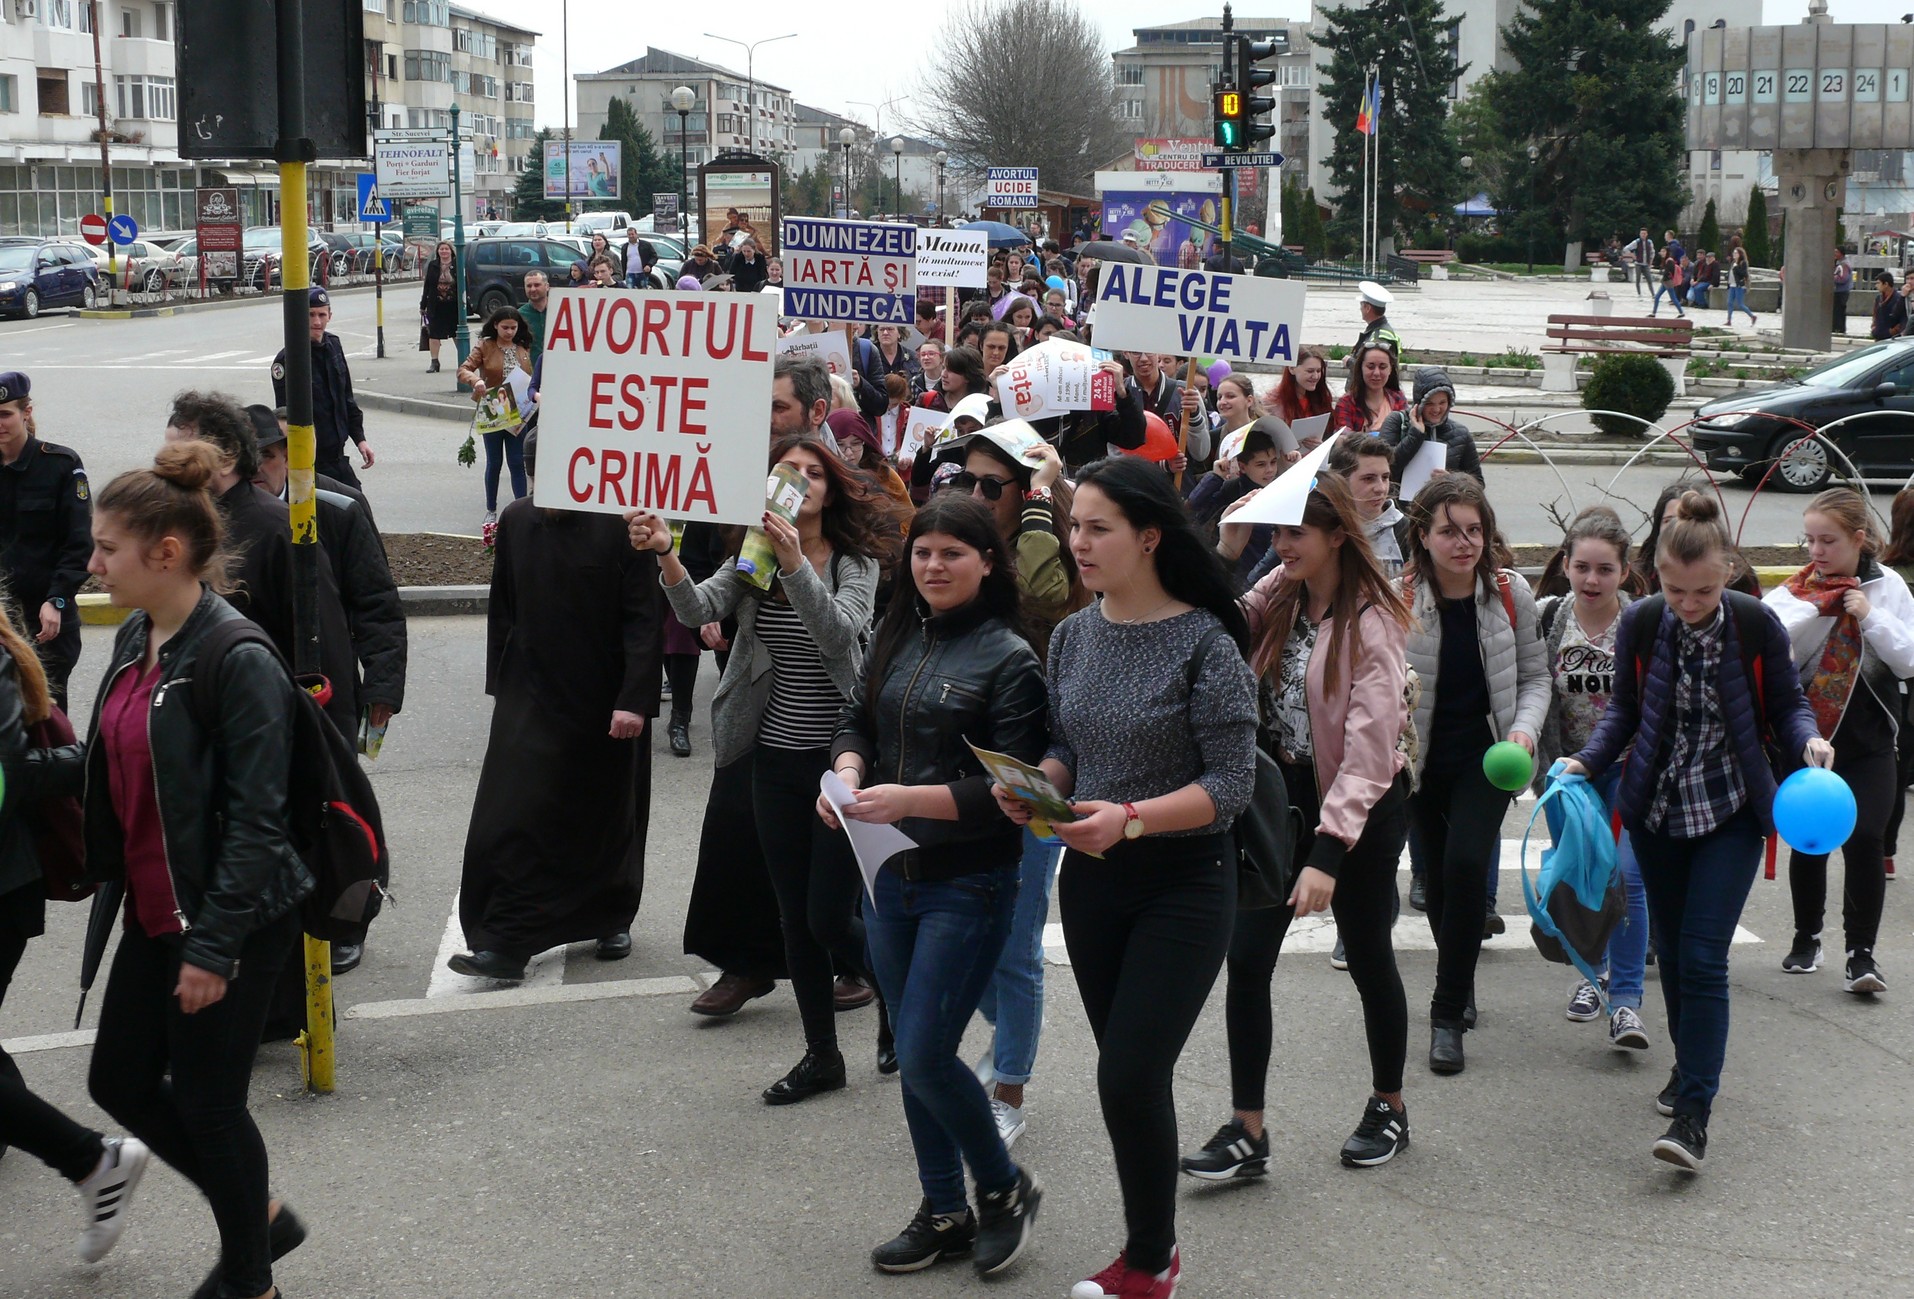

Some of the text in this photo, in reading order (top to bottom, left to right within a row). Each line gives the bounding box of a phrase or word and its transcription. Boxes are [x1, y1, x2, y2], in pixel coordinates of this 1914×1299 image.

[1707, 78, 1717, 95] 19
[1728, 77, 1744, 95] 20
[1757, 76, 1773, 94] 21
[1788, 75, 1808, 94] 22
[1823, 75, 1843, 93] 23
[1856, 74, 1875, 93] 24
[1893, 74, 1899, 93] 1
[1223, 93, 1239, 115] 10
[378, 149, 445, 159] TEHNOFALT
[411, 168, 431, 177] forjat
[990, 169, 1036, 179] AVORTUL
[1145, 161, 1200, 170] TRADUCERI
[995, 182, 1032, 193] UCIDE
[785, 223, 915, 254] DUMNEZEU
[917, 235, 986, 256] Mama,
[793, 255, 874, 286] IARTĂ
[917, 270, 929, 278] ca
[1100, 264, 1233, 314] ALEGE
[791, 291, 907, 322] VINDECĂ
[546, 297, 769, 363] AVORTUL
[1178, 313, 1293, 363] VIAȚA
[588, 372, 709, 436] ESTE
[567, 442, 718, 515] CRIMĂ
